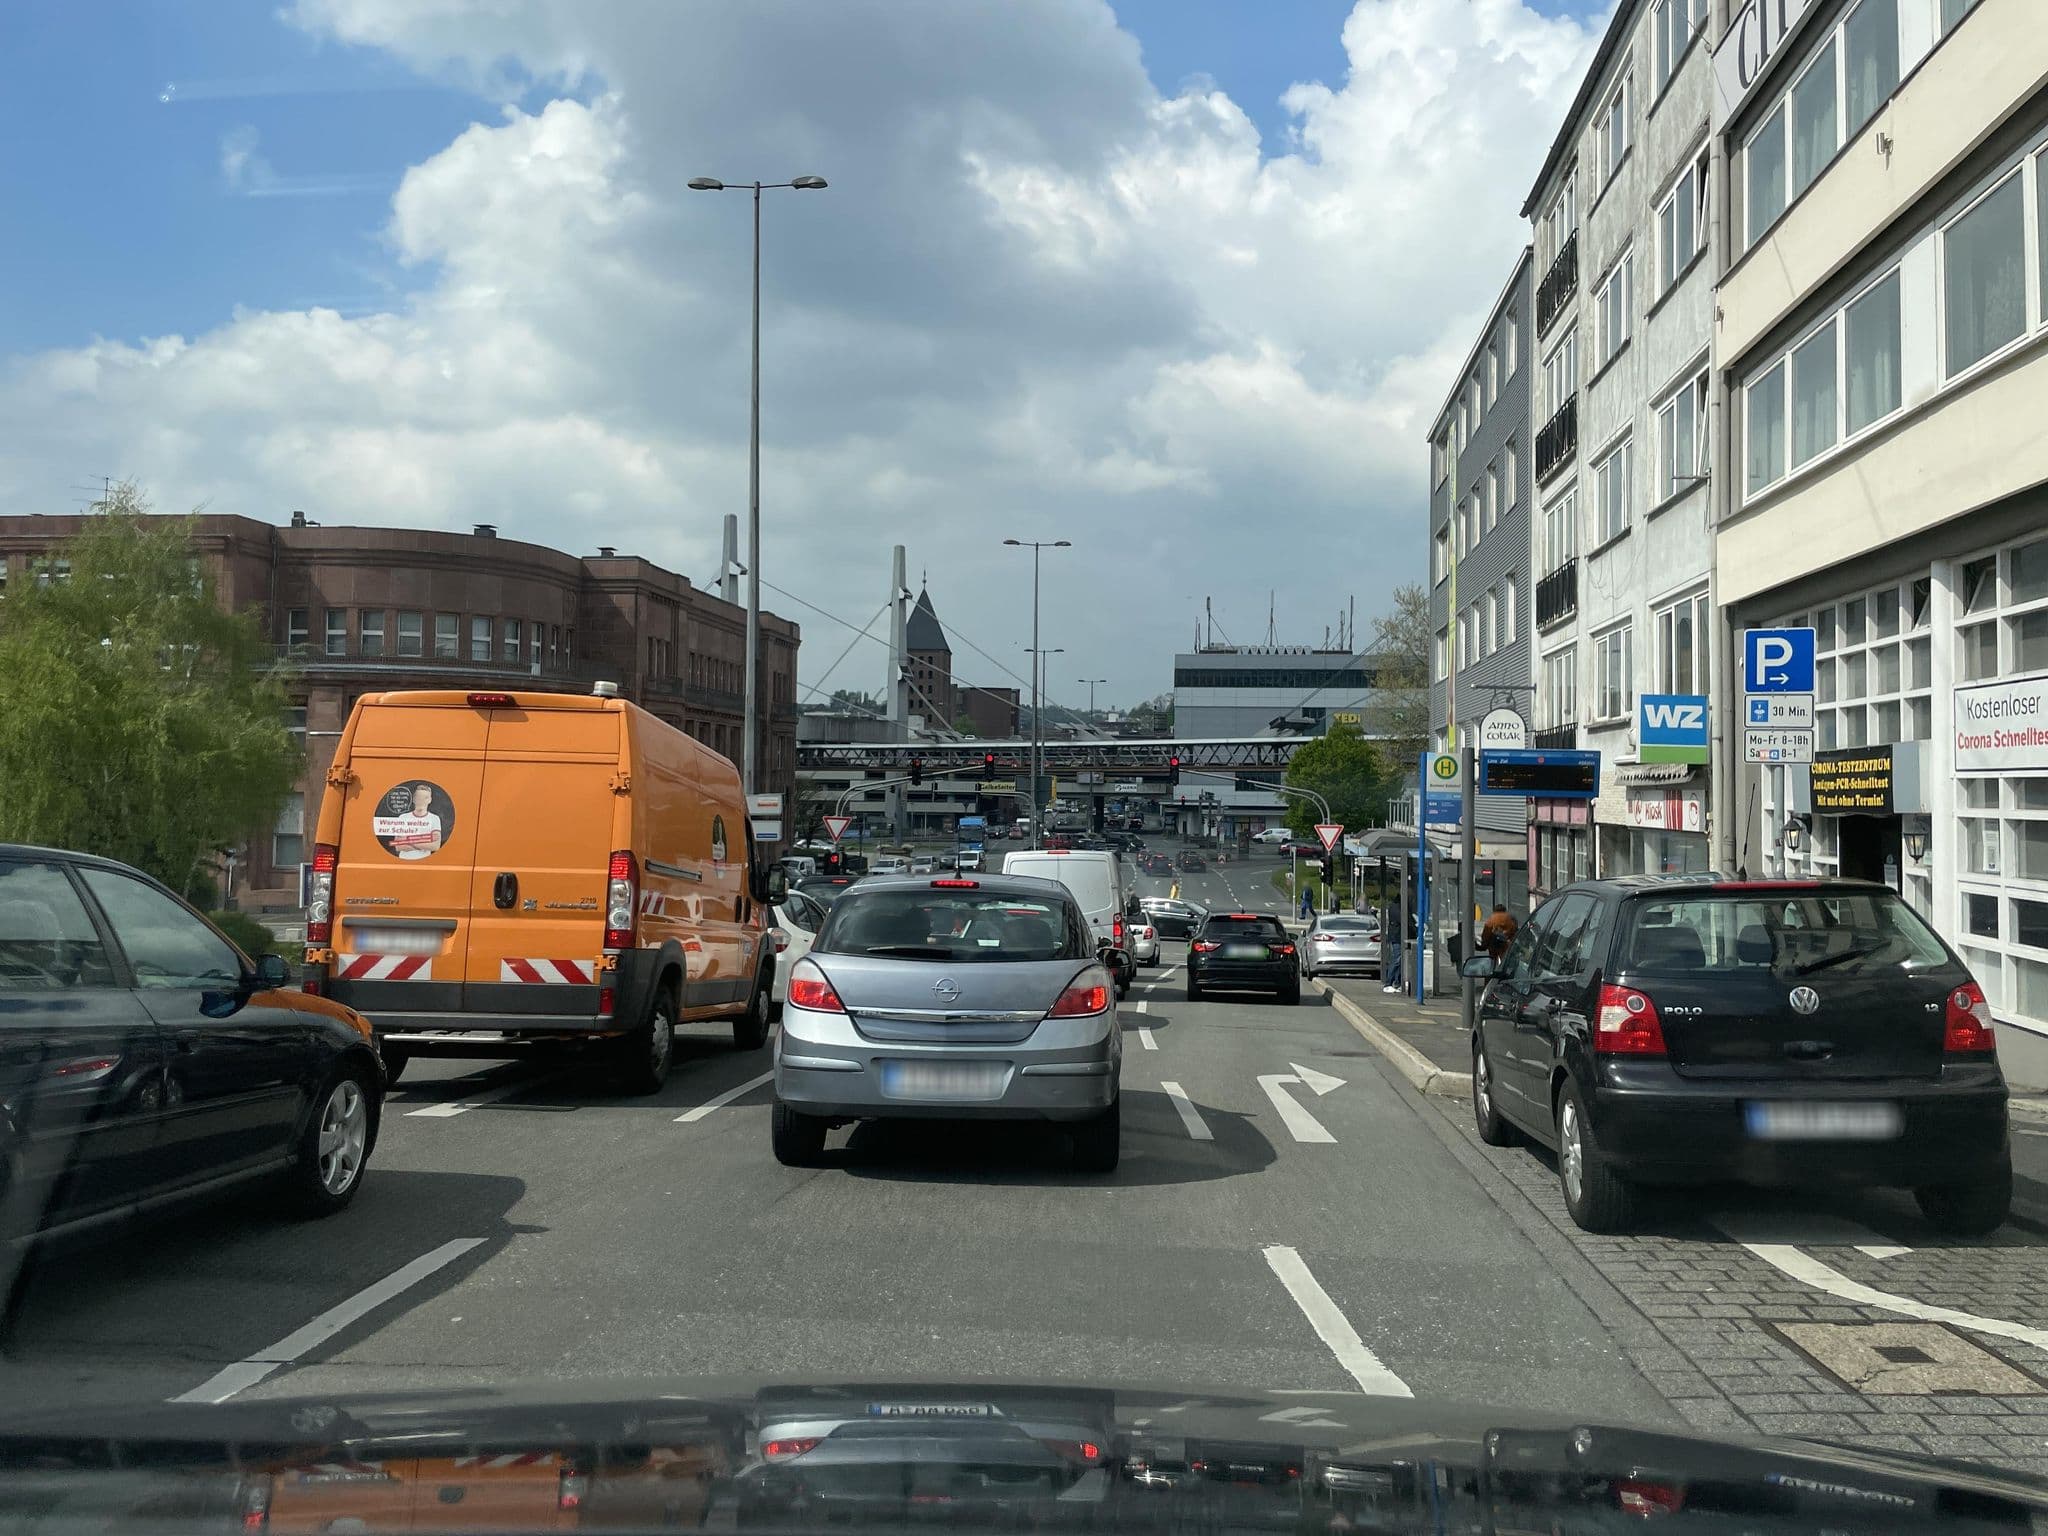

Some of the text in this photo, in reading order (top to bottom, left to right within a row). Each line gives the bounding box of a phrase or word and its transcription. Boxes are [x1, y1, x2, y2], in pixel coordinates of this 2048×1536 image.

[1756, 638, 1793, 685] P
[1772, 706, 1808, 716] 30 Min.
[1966, 693, 2041, 720] Kostenloser
[1644, 704, 1703, 728] WZ
[1750, 735, 1808, 745] Mo-Fr 8-18h
[1957, 732, 1992, 749] Corona
[1811, 758, 1890, 774] CORONA-TESTZENTRUM
[1855, 793, 1884, 806] Termin!
[1645, 801, 1662, 820] Kiosk
[1664, 1006, 1703, 1015] POLO
